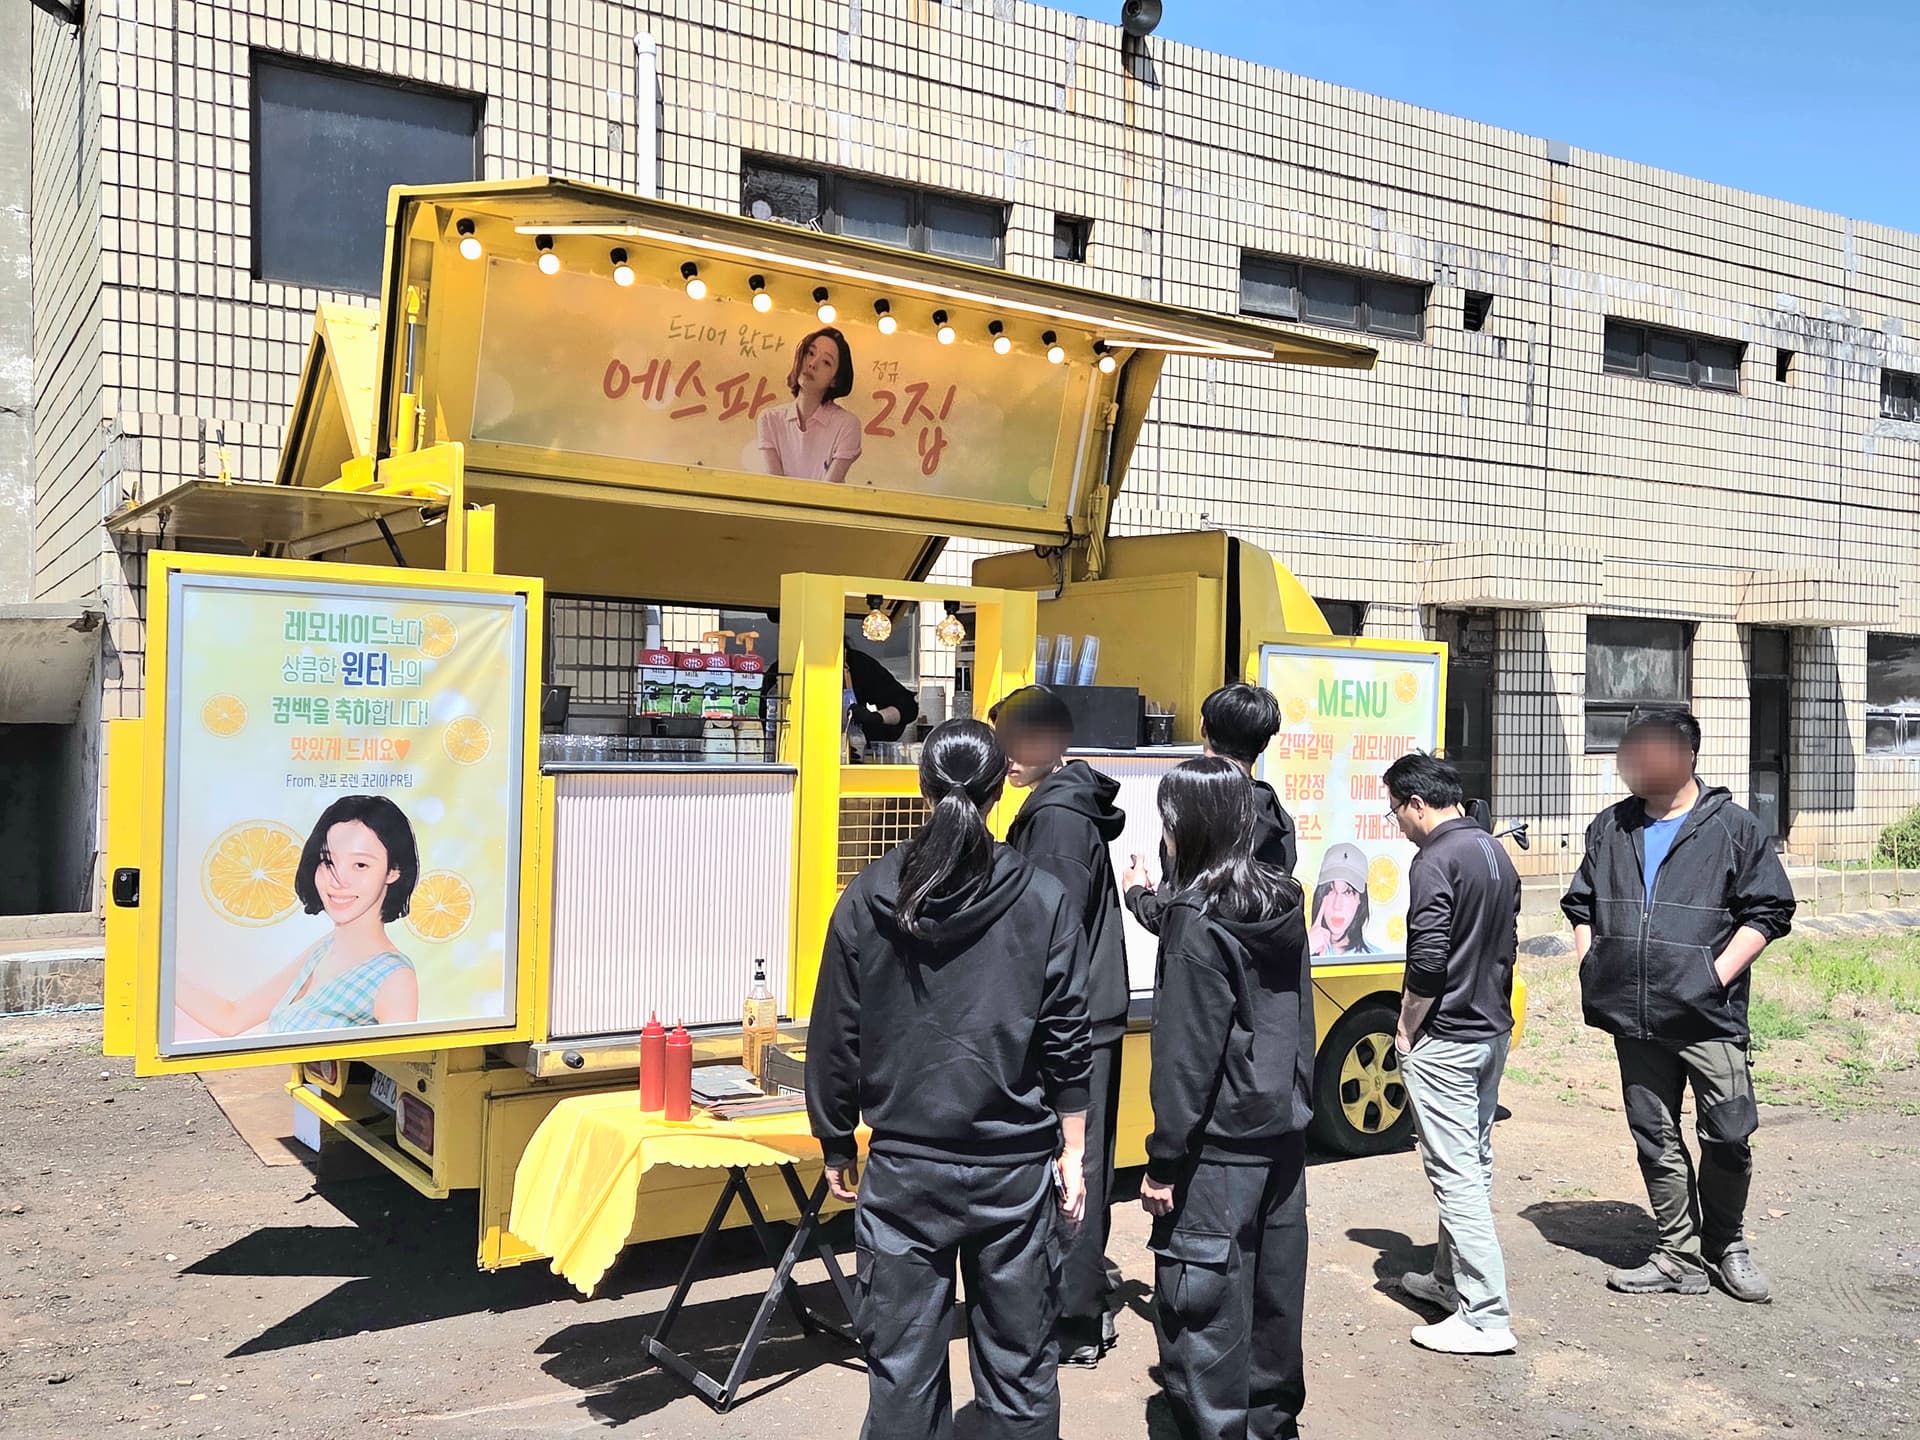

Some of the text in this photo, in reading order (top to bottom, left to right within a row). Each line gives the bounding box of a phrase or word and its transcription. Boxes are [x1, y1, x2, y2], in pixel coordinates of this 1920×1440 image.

[668, 313, 786, 359] 드디어 왔다
[871, 359, 900, 385] 정규
[602, 358, 777, 422] 에스파
[864, 382, 958, 476] 2집
[284, 610, 424, 647] 레모네이드보다
[282, 650, 423, 687] 상큼한 윈터님의
[272, 696, 429, 726] 컴백을 축하합니다!
[1317, 678, 1388, 719] MENU
[290, 736, 342, 761] 맛있게
[1279, 732, 1335, 761] 갈떡갈떡
[319, 772, 338, 789] 랄프
[339, 773, 359, 789] 로렌
[361, 773, 389, 789] 코리아
[390, 773, 414, 789] PR팀
[1284, 773, 1326, 801] 닭강정
